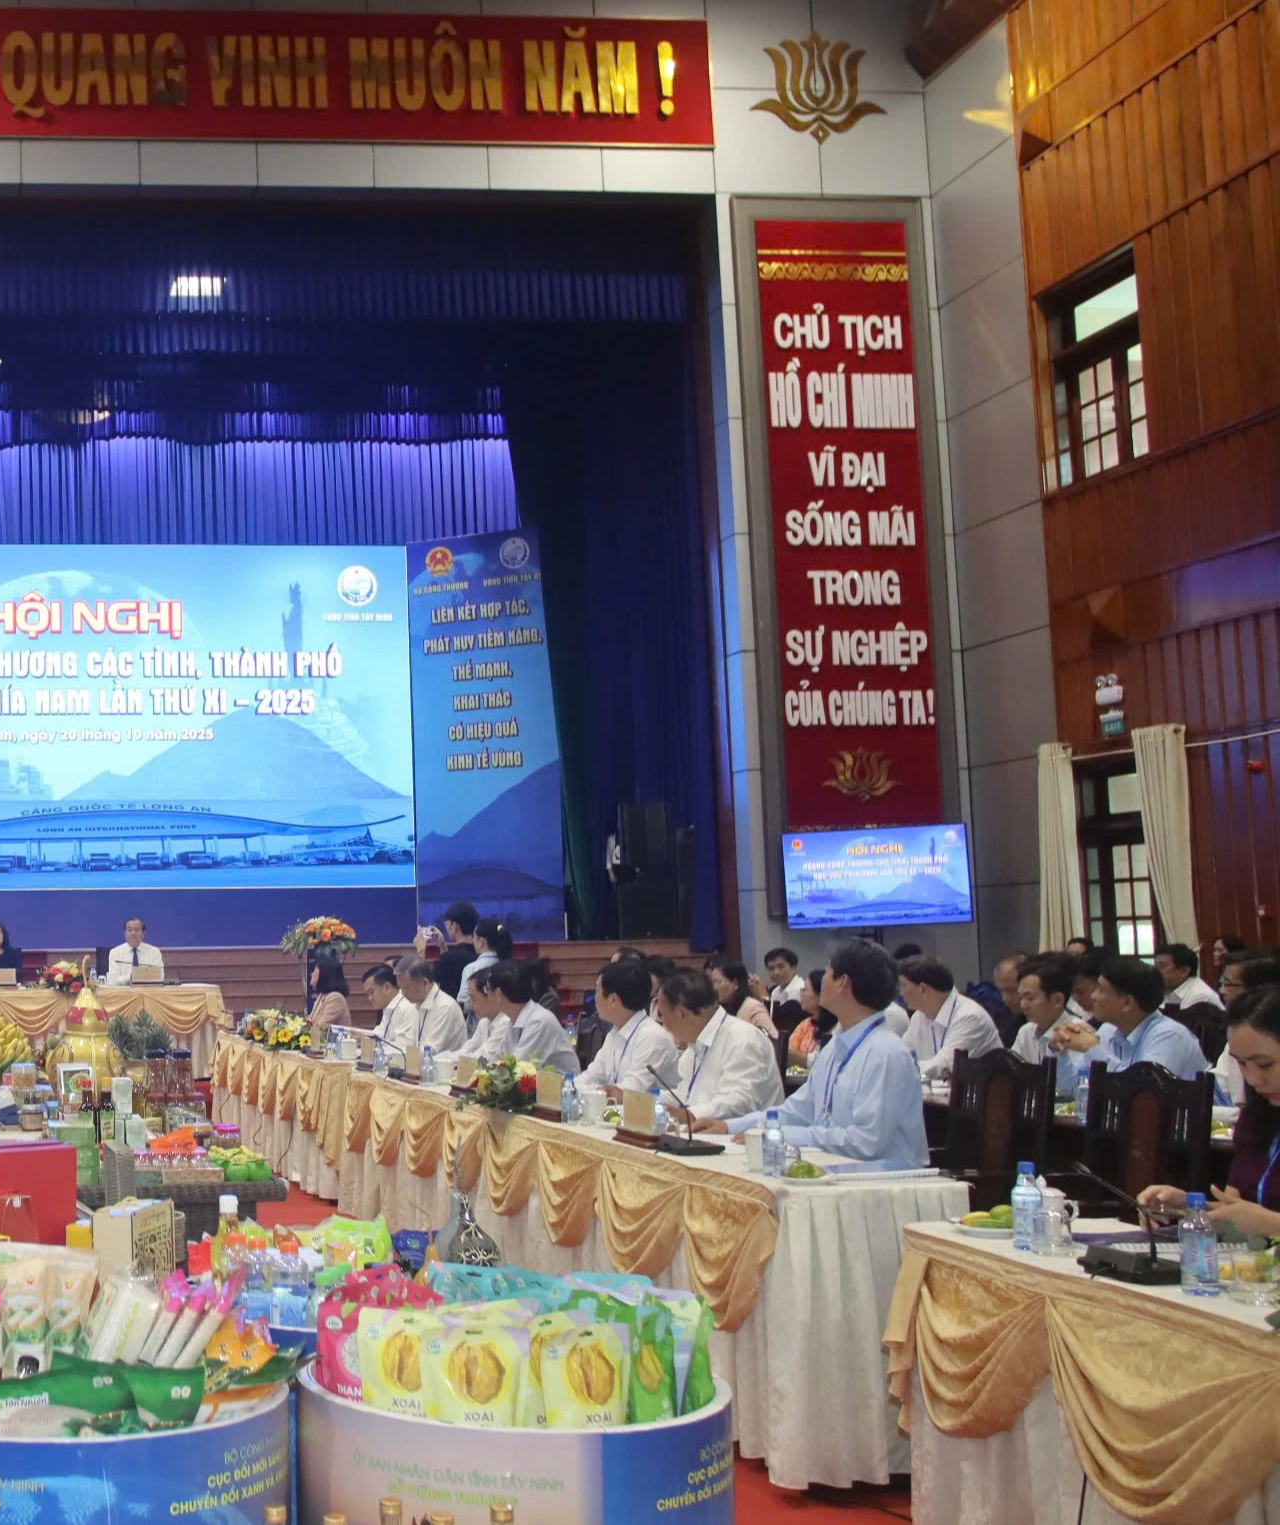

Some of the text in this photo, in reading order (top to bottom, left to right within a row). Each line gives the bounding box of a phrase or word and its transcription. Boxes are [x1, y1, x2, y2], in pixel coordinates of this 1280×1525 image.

[1, 30, 187, 118] QUANG
[204, 34, 328, 107] VINH
[348, 20, 503, 112] MUÔN
[523, 26, 639, 114] NĂM
[657, 41, 675, 116] !
[773, 303, 903, 356] CHỦ TỊCH
[768, 357, 915, 429] HỒ CHÍ MINH
[808, 445, 886, 493] VĨ ĐẠI
[785, 500, 915, 546] SỐNG MÃI
[807, 569, 901, 606] TRONG
[72, 600, 183, 639] NGHỊ
[432, 605, 455, 624] LIÊN
[458, 601, 477, 620] KẾT
[480, 602, 502, 621] HỢP
[424, 635, 450, 655] PHÁT
[453, 635, 475, 651] HUY
[477, 628, 505, 649] TIỀM
[786, 621, 928, 673] SỰ NGHIỆP
[86, 646, 133, 678] CÁC
[140, 644, 204, 680] TỈNH,
[210, 646, 288, 678] THÀNH
[293, 642, 342, 678] PHỐ
[452, 659, 473, 681] THẾ
[34, 688, 90, 715] NAM
[98, 679, 144, 715] LẦN
[150, 685, 198, 715] THỨ
[202, 688, 228, 715] XI
[255, 688, 316, 715] 2025
[453, 689, 511, 711] KHAI THÁC
[785, 679, 826, 727] CỦA
[828, 681, 896, 726] CHÚNG
[21, 729, 57, 744] ngày
[60, 730, 77, 741] 20
[81, 729, 121, 744] tháng
[126, 730, 142, 741] 10
[181, 730, 215, 741] 2025
[448, 716, 519, 742] CÓ HIỆU QUẢ
[447, 748, 523, 771] KINH TẾ VÙNG
[142, 803, 184, 811] LONG
[190, 805, 211, 813] AN
[11, 1478, 44, 1492] NINH
[207, 1473, 231, 1490] CỤC
[170, 1491, 218, 1516] CHUYỂN
[221, 1484, 239, 1506] ĐỔI
